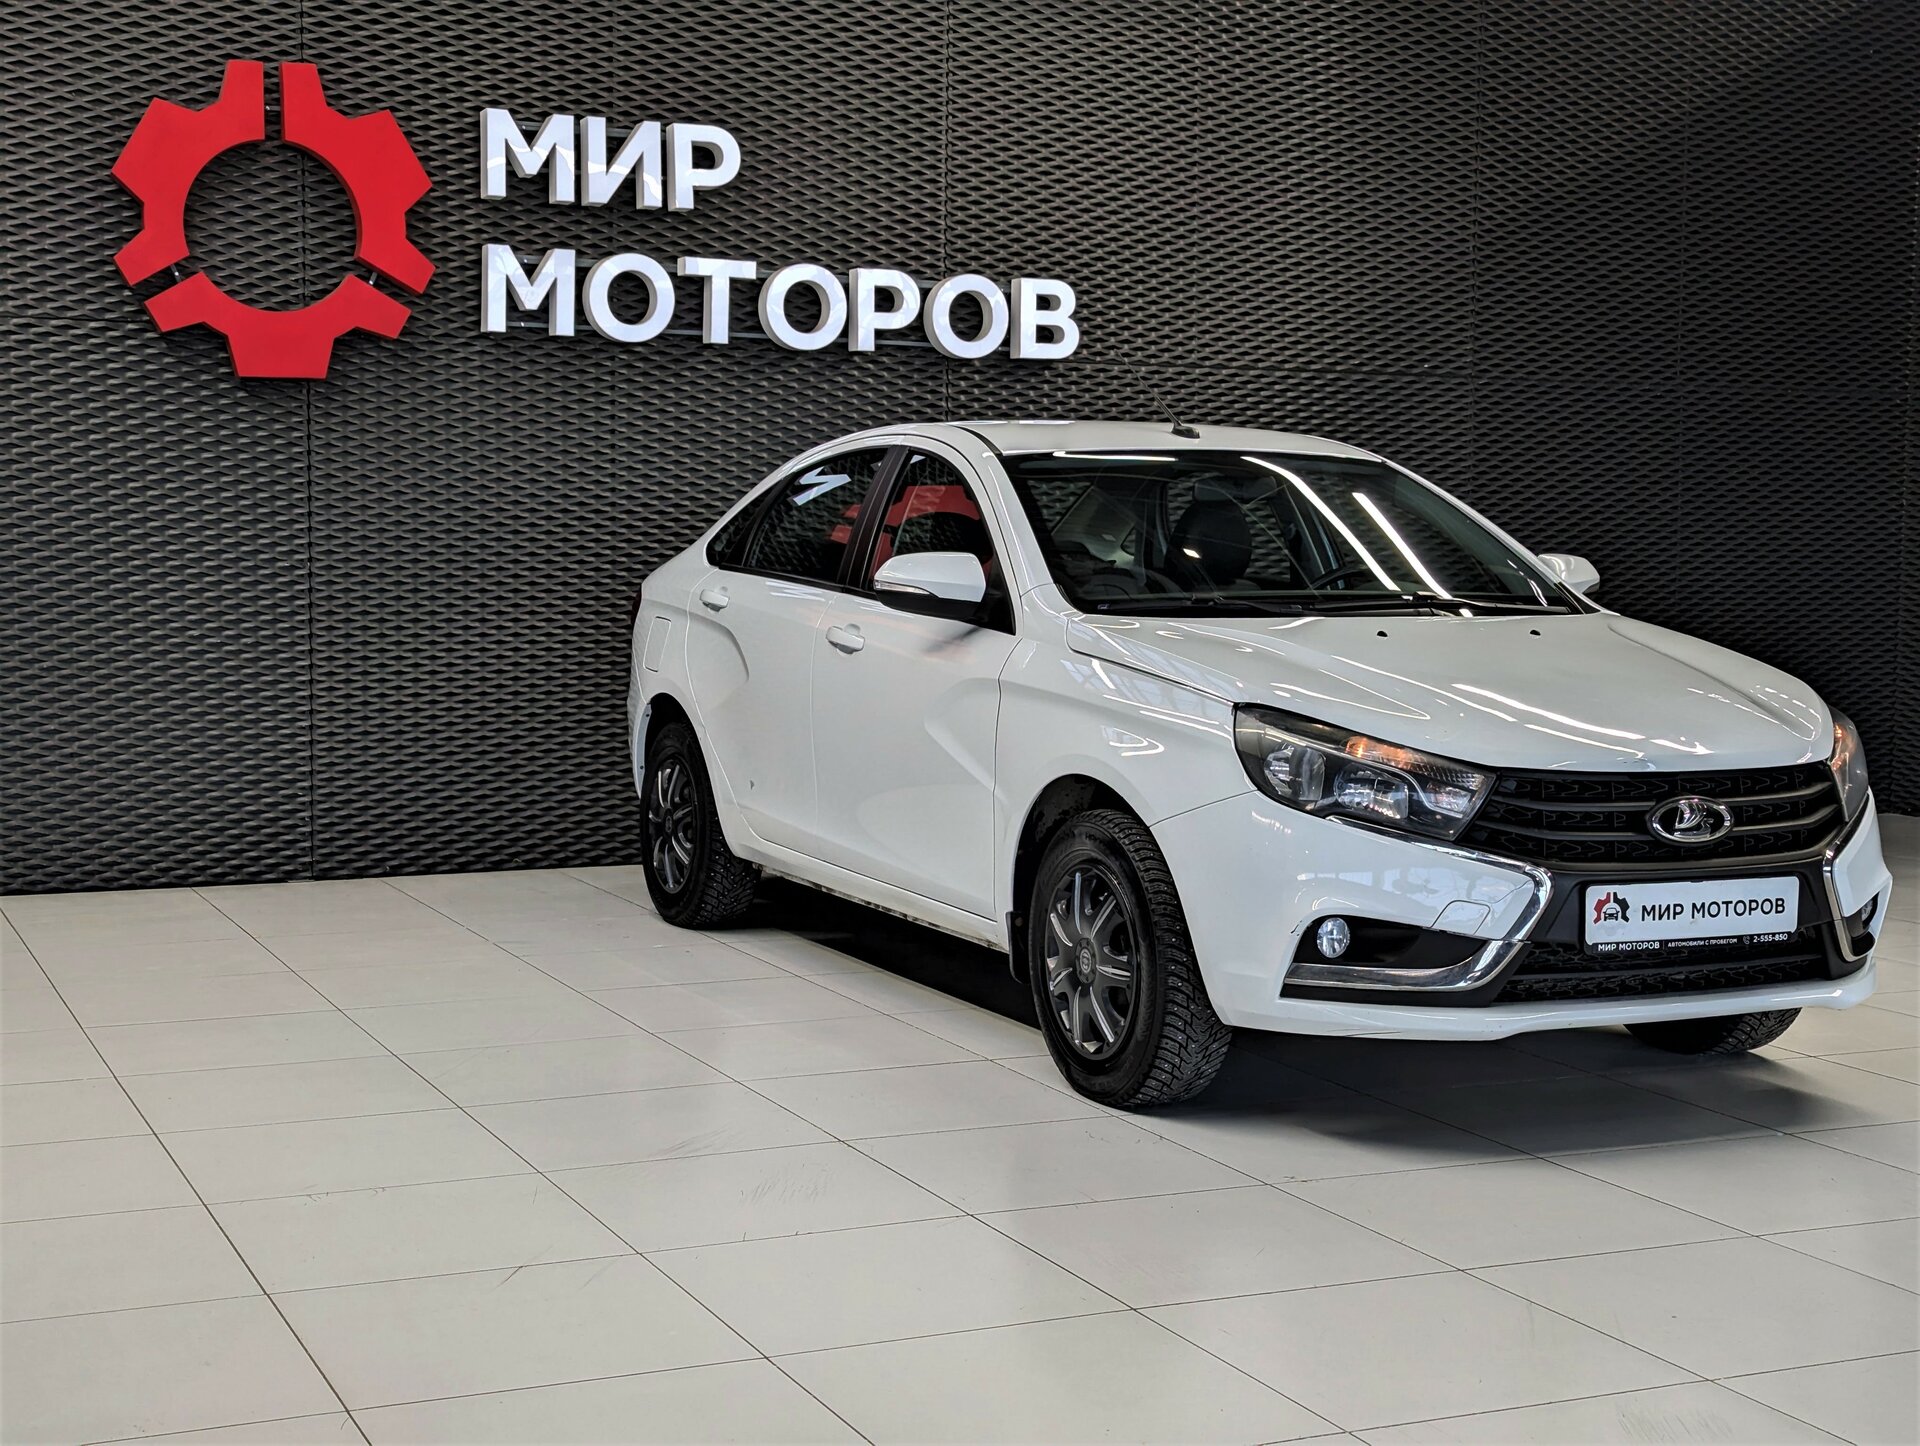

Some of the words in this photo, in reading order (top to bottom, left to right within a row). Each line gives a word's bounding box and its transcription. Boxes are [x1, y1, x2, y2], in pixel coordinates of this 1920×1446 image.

[480, 107, 742, 211] МИР
[480, 243, 1080, 360] МОТОРОВ
[1641, 903, 1684, 922] МИР
[1691, 897, 1786, 919] МОТОРОВ
[1598, 943, 1617, 952] МИР
[1618, 941, 1660, 951] МОТОРОВ
[1667, 940, 1704, 948] АВТОМОБИЛИ
[1753, 933, 1788, 943] 2-555-850
